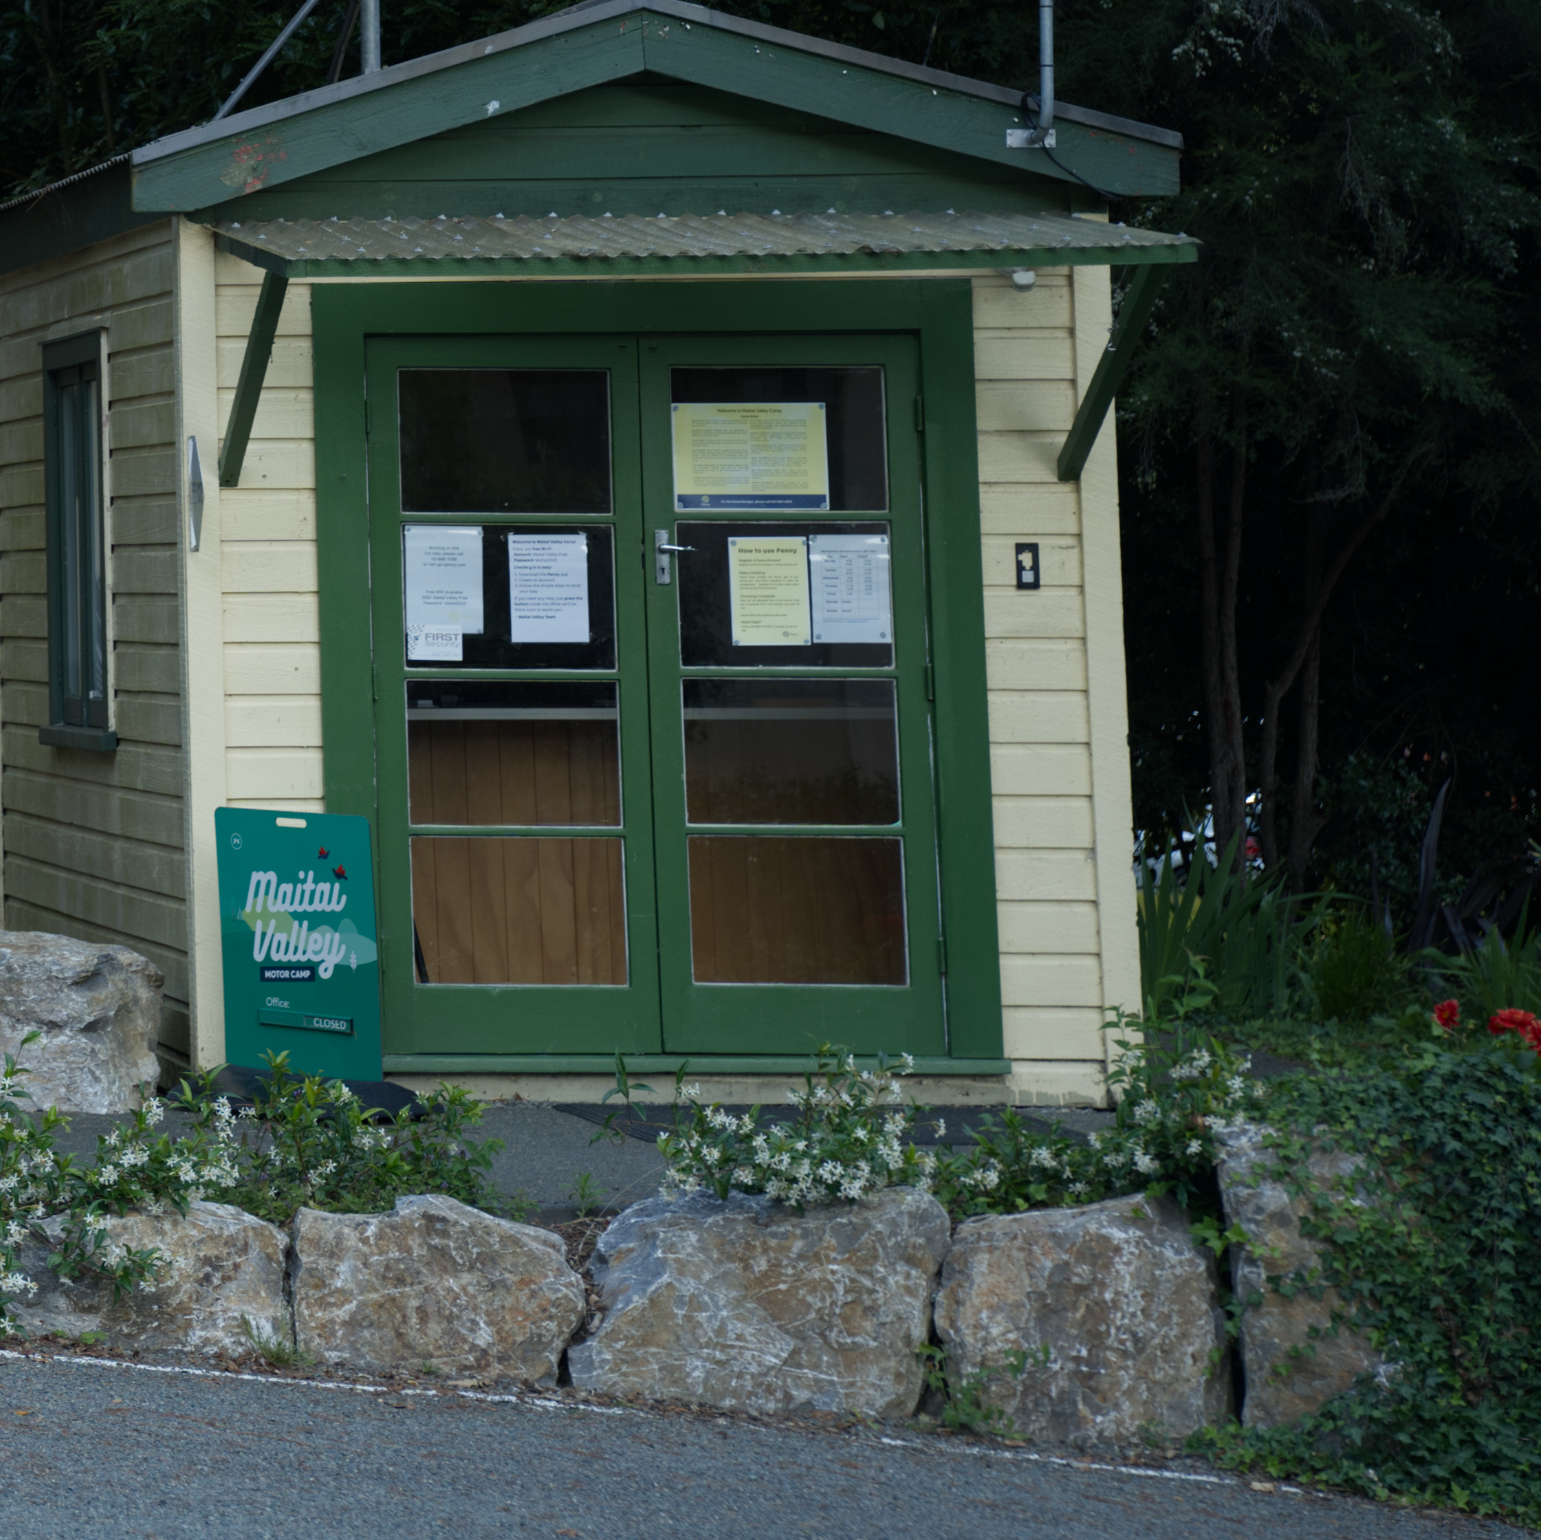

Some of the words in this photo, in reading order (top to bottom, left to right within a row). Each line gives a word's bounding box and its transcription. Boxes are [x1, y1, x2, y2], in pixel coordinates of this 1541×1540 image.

[425, 633, 460, 641] FIRST
[245, 870, 347, 913] Maitai
[253, 918, 346, 980] Valley
[264, 970, 290, 979] MOTOR
[290, 970, 311, 979] CAMP
[313, 1018, 347, 1030] CLOSED
